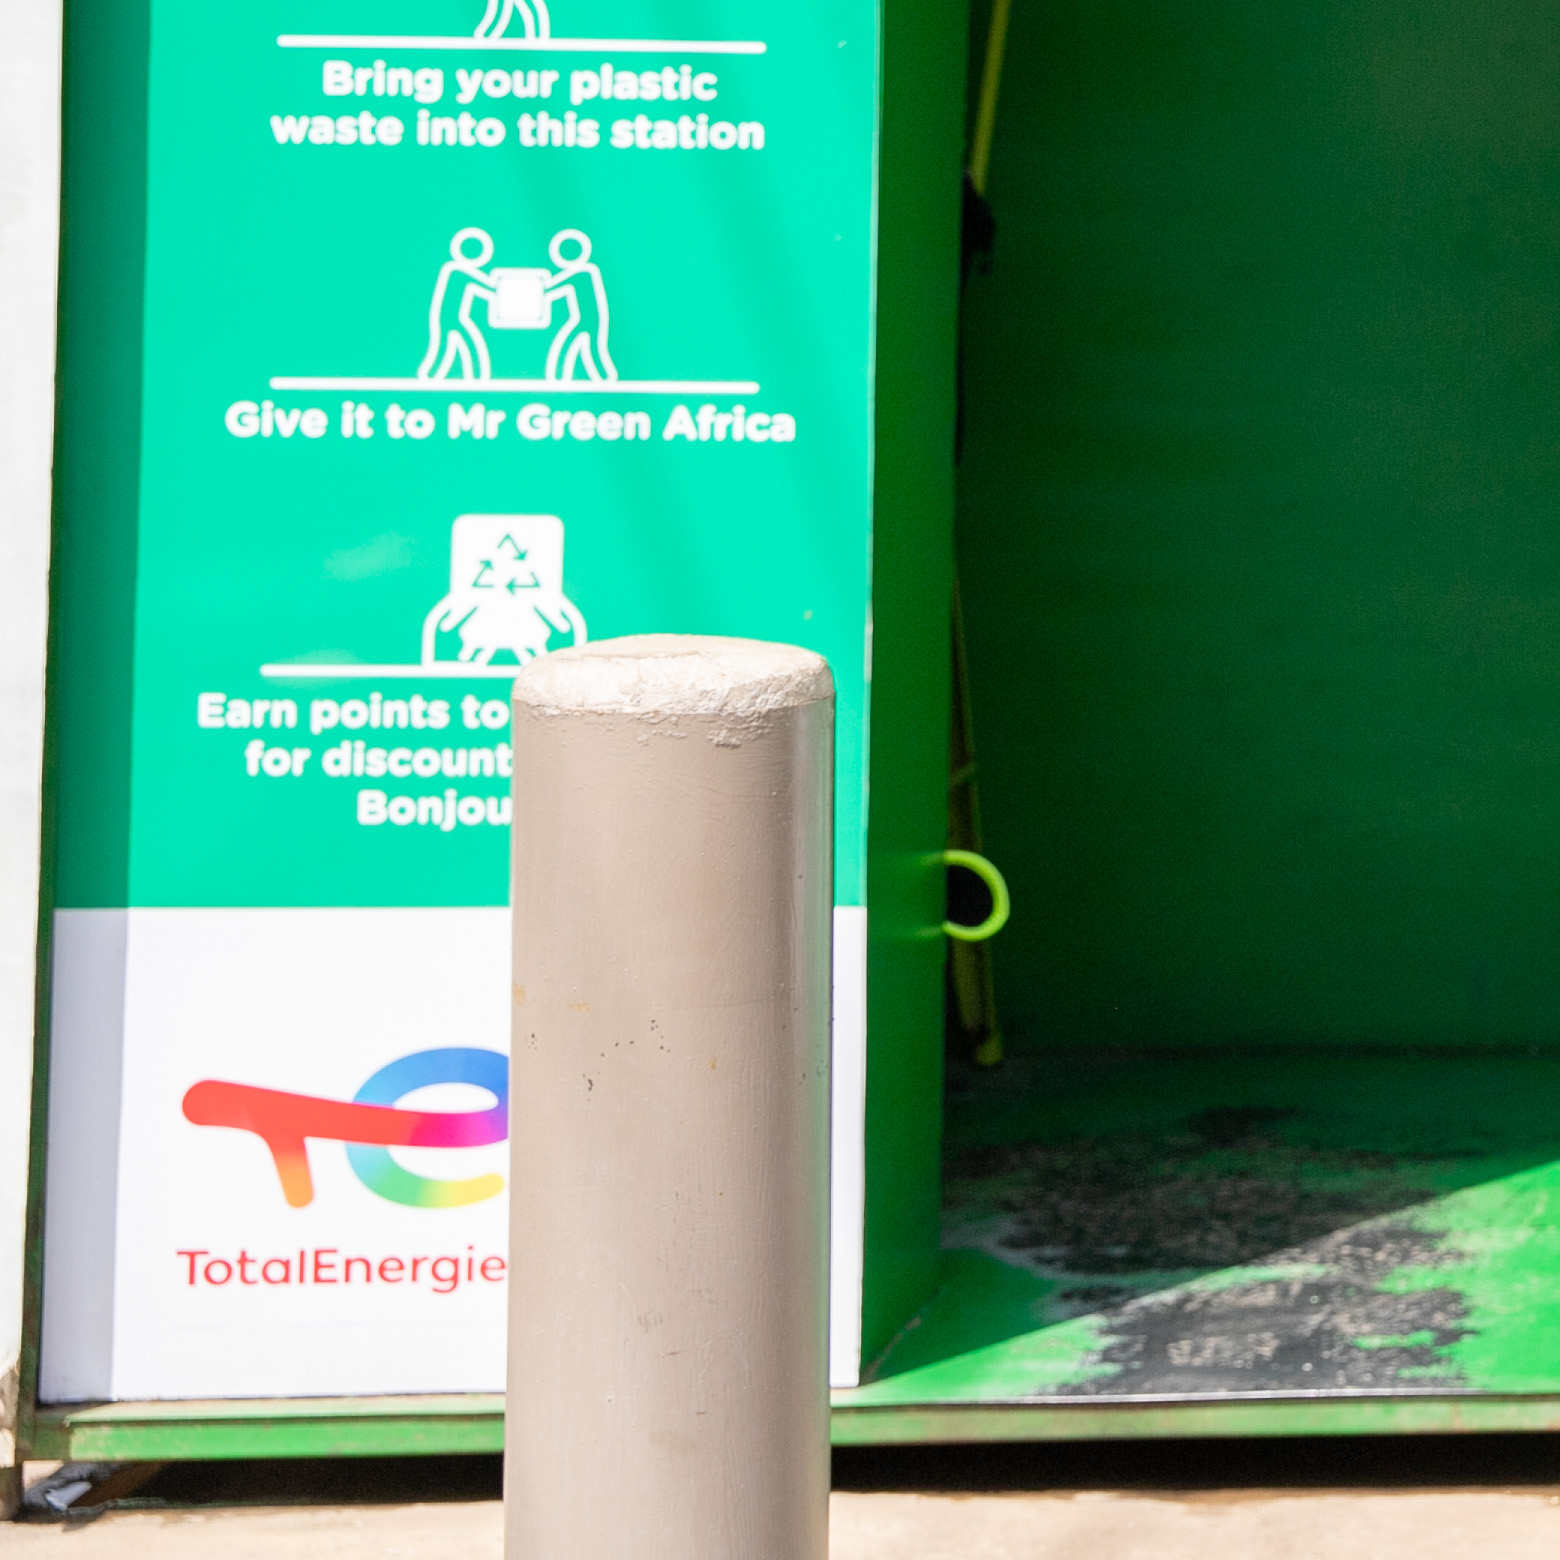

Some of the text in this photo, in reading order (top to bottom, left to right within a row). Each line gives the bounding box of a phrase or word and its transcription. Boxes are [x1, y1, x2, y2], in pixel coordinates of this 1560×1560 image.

[323, 60, 718, 105] Bring your plastic
[270, 109, 765, 150] waste into this station
[225, 400, 796, 442] Give it to Mr Green Africa
[198, 692, 511, 735] Earn points to
[245, 739, 513, 777] for discount
[357, 788, 513, 832] Bonjou
[177, 1245, 506, 1293] TotalEnergie
